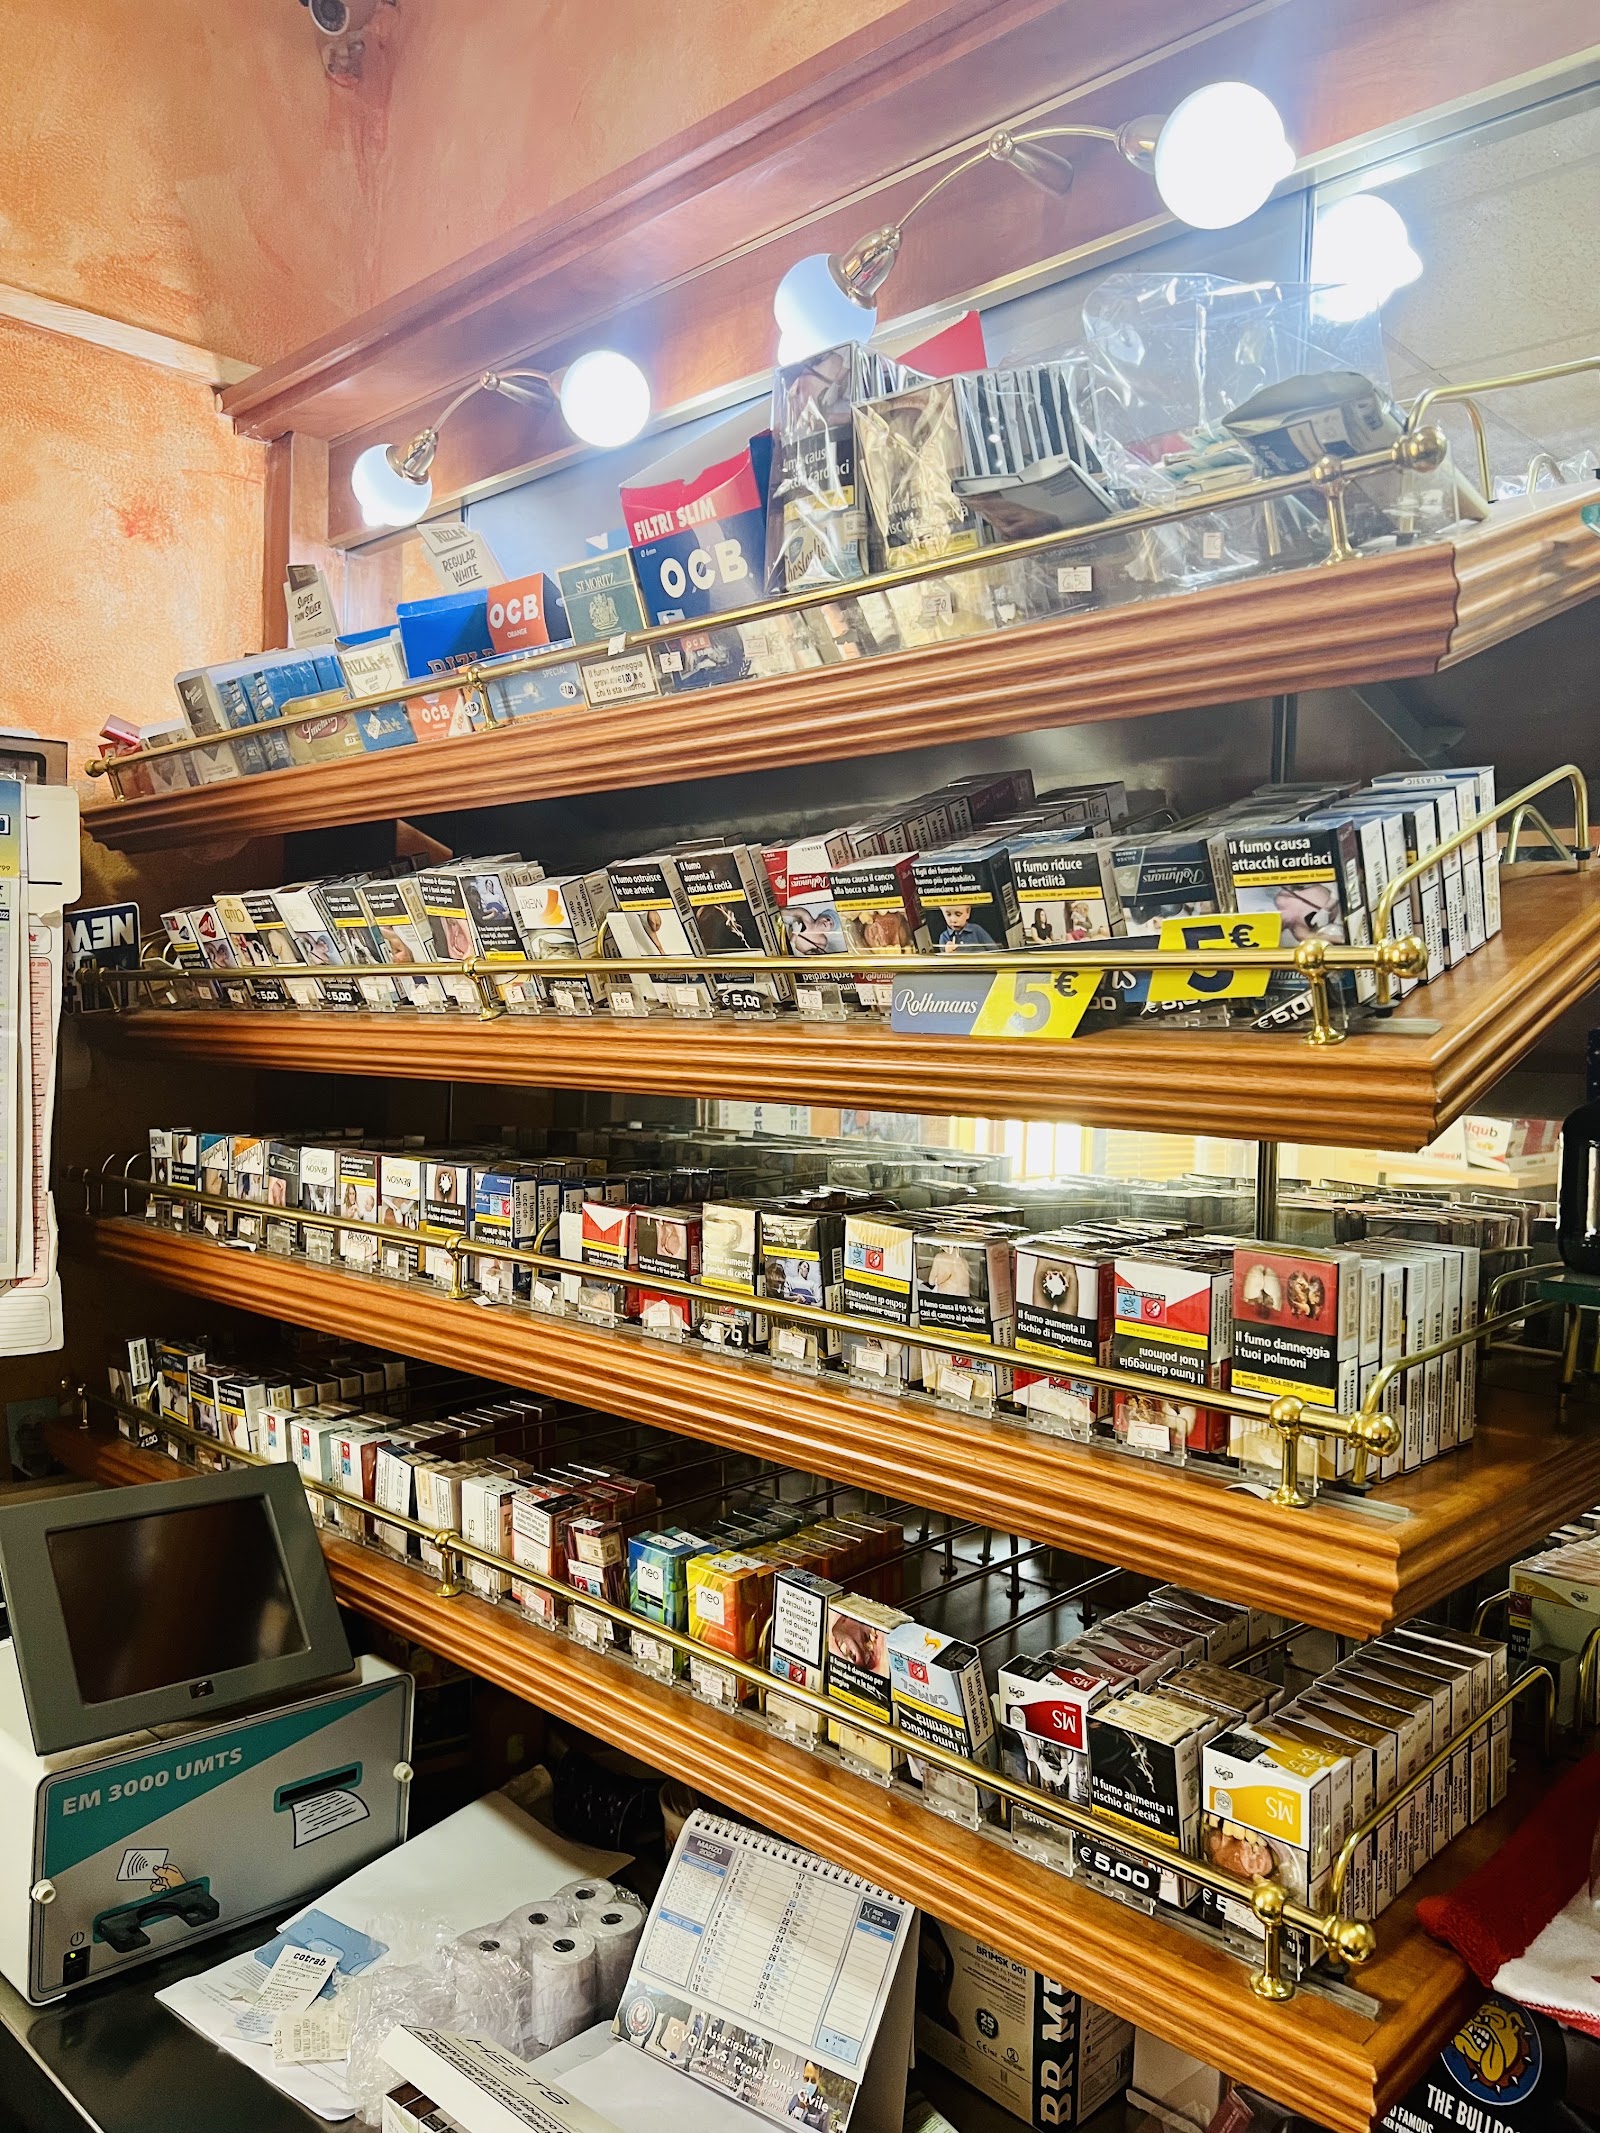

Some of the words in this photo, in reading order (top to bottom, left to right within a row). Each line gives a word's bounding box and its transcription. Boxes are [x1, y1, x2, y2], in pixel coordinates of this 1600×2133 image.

[634, 514, 673, 542] FILTRI
[677, 498, 716, 527] SLIM
[442, 549, 477, 573] REGULAR
[661, 539, 749, 598] OCB
[452, 565, 481, 583] WHITE
[297, 592, 314, 609] SUPER
[294, 608, 305, 623] THIN
[305, 600, 322, 620] SILVER
[490, 594, 540, 629] OCB
[507, 627, 527, 639] ORANGE
[542, 666, 568, 678] SPECIAL
[594, 668, 610, 677] fumo
[611, 660, 643, 673] danneggia
[422, 704, 450, 723] OCB
[1406, 776, 1444, 785] CLASSIC
[1228, 841, 1237, 854] Il
[1239, 839, 1266, 853] fumo
[1266, 838, 1311, 851] causa
[679, 862, 685, 871] Il
[685, 861, 701, 870] fumo
[1014, 860, 1021, 873] Il
[1022, 861, 1049, 872] fumo
[1050, 858, 1082, 871] riduce
[1232, 855, 1280, 871] attacchi
[1282, 851, 1332, 868] cardiaci
[611, 875, 616, 884] Il
[616, 875, 632, 884] fumo
[633, 873, 662, 882] ostruisce
[684, 872, 709, 882] aumenta
[710, 870, 715, 880] il
[830, 876, 835, 885] Il
[835, 875, 851, 884] fumo
[852, 875, 868, 883] causa
[869, 873, 874, 882] il
[874, 872, 895, 881] cancro
[915, 876, 931, 885] hanno
[933, 876, 942, 885] più
[943, 873, 975, 884] probabilità
[916, 867, 927, 876] figli
[928, 866, 936, 874] dei
[937, 865, 963, 874] fumatori
[1142, 868, 1205, 885] Rothmans
[687, 883, 705, 893] rischio
[714, 880, 733, 890] cecità
[790, 875, 830, 888] Rothmans
[834, 885, 845, 895] alla
[847, 884, 862, 893] bocca
[867, 883, 879, 892] alla
[880, 883, 894, 892] gola
[925, 885, 953, 893] cominciare
[960, 883, 981, 892] fumare
[1017, 876, 1026, 888] la
[1028, 873, 1066, 888] fertilità
[615, 887, 623, 896] le
[624, 887, 634, 895] tue
[636, 885, 655, 894] arterie
[520, 897, 543, 910] MERIT
[65, 912, 135, 954] NEW
[327, 991, 352, 1002] €5,00
[722, 994, 760, 1008] €5,00
[895, 989, 978, 1015] Rothmans
[386, 1175, 411, 1187] BENSON
[347, 1231, 372, 1242] BENSON
[920, 1299, 924, 1308] Il
[925, 1300, 938, 1312] fumo
[939, 1303, 952, 1312] causa
[953, 1303, 958, 1312] il
[959, 1304, 966, 1313] 90
[968, 1306, 974, 1314] %
[975, 1306, 984, 1314] dei
[920, 1308, 929, 1318] casi
[930, 1310, 936, 1318] di
[937, 1313, 954, 1322] cancro
[956, 1314, 961, 1322] ai
[962, 1314, 986, 1324] polmoni
[1018, 1310, 1023, 1320] Il
[1024, 1311, 1043, 1326] fumo
[1044, 1318, 1077, 1333] aumenta
[1078, 1324, 1086, 1334] il
[1018, 1322, 1042, 1336] rischio
[1043, 1327, 1050, 1337] di
[1052, 1330, 1092, 1348] impotenza
[1236, 1330, 1243, 1343] Il
[1244, 1331, 1270, 1349] fumo
[1272, 1338, 1331, 1360] danneggia
[1139, 1347, 1173, 1364] polmoni
[1177, 1353, 1199, 1368] tuoi
[1200, 1357, 1204, 1369] i
[1235, 1346, 1239, 1357] i
[1240, 1346, 1262, 1361] tuoi
[1264, 1352, 1307, 1371] polmoni
[1120, 1357, 1169, 1376] danneggia
[1170, 1367, 1196, 1384] fumo
[1197, 1368, 1204, 1384] Il
[570, 1562, 581, 1573] neo
[640, 1566, 660, 1580] neo
[700, 1590, 720, 1606] neo
[786, 1590, 807, 1604] fumare
[782, 1598, 815, 1617] cominciare
[782, 1617, 792, 1628] più
[794, 1623, 812, 1636] hanno
[783, 1637, 793, 1646] dei
[784, 1628, 809, 1644] fumatori
[795, 1641, 805, 1653] figli
[901, 1678, 949, 1706] CAMEL
[967, 1677, 976, 1706] smetti
[972, 1707, 981, 1736] subito
[979, 1697, 988, 1728] uccide
[901, 1718, 931, 1739] riduce
[915, 1713, 953, 1738] fertilità
[1052, 1709, 1077, 1733] MS
[932, 1736, 959, 1753] fumo
[954, 1730, 966, 1743] la
[961, 1746, 969, 1757] Il
[62, 1791, 100, 1817] EM
[108, 1771, 169, 1802] 3000
[175, 1747, 243, 1781] UMTS
[1092, 1776, 1099, 1788] Il
[1099, 1779, 1122, 1801] fumo
[1125, 1789, 1164, 1812] aumenta
[1166, 1805, 1174, 1817] il
[1093, 1788, 1122, 1809] rischio
[1123, 1801, 1132, 1813] di
[1134, 1804, 1161, 1826] cecità
[1265, 1797, 1294, 1825] MS
[696, 1840, 723, 1854] MARZO
[699, 1849, 716, 1858] 2022
[1079, 1846, 1149, 1890] €5,00
[293, 1952, 327, 1966] cotrab
[976, 1945, 1009, 1969] BR1MSK
[1011, 1963, 1027, 1977] 001
[980, 2012, 995, 2029] 25
[705, 2026, 764, 2062] Associazione
[772, 2058, 800, 2080] Onlus
[466, 2038, 570, 2105] HEETS
[429, 2033, 456, 2058] Questo
[458, 2055, 500, 2088] prodotto
[500, 2088, 520, 2099] del
[517, 2099, 557, 2130] tabacco
[733, 2057, 794, 2095] Protezione
[797, 2089, 829, 2113] Civile
[1040, 2059, 1074, 2126] BR
[1427, 2083, 1456, 2120] THE
[1398, 2107, 1434, 2133] FAMOUS
